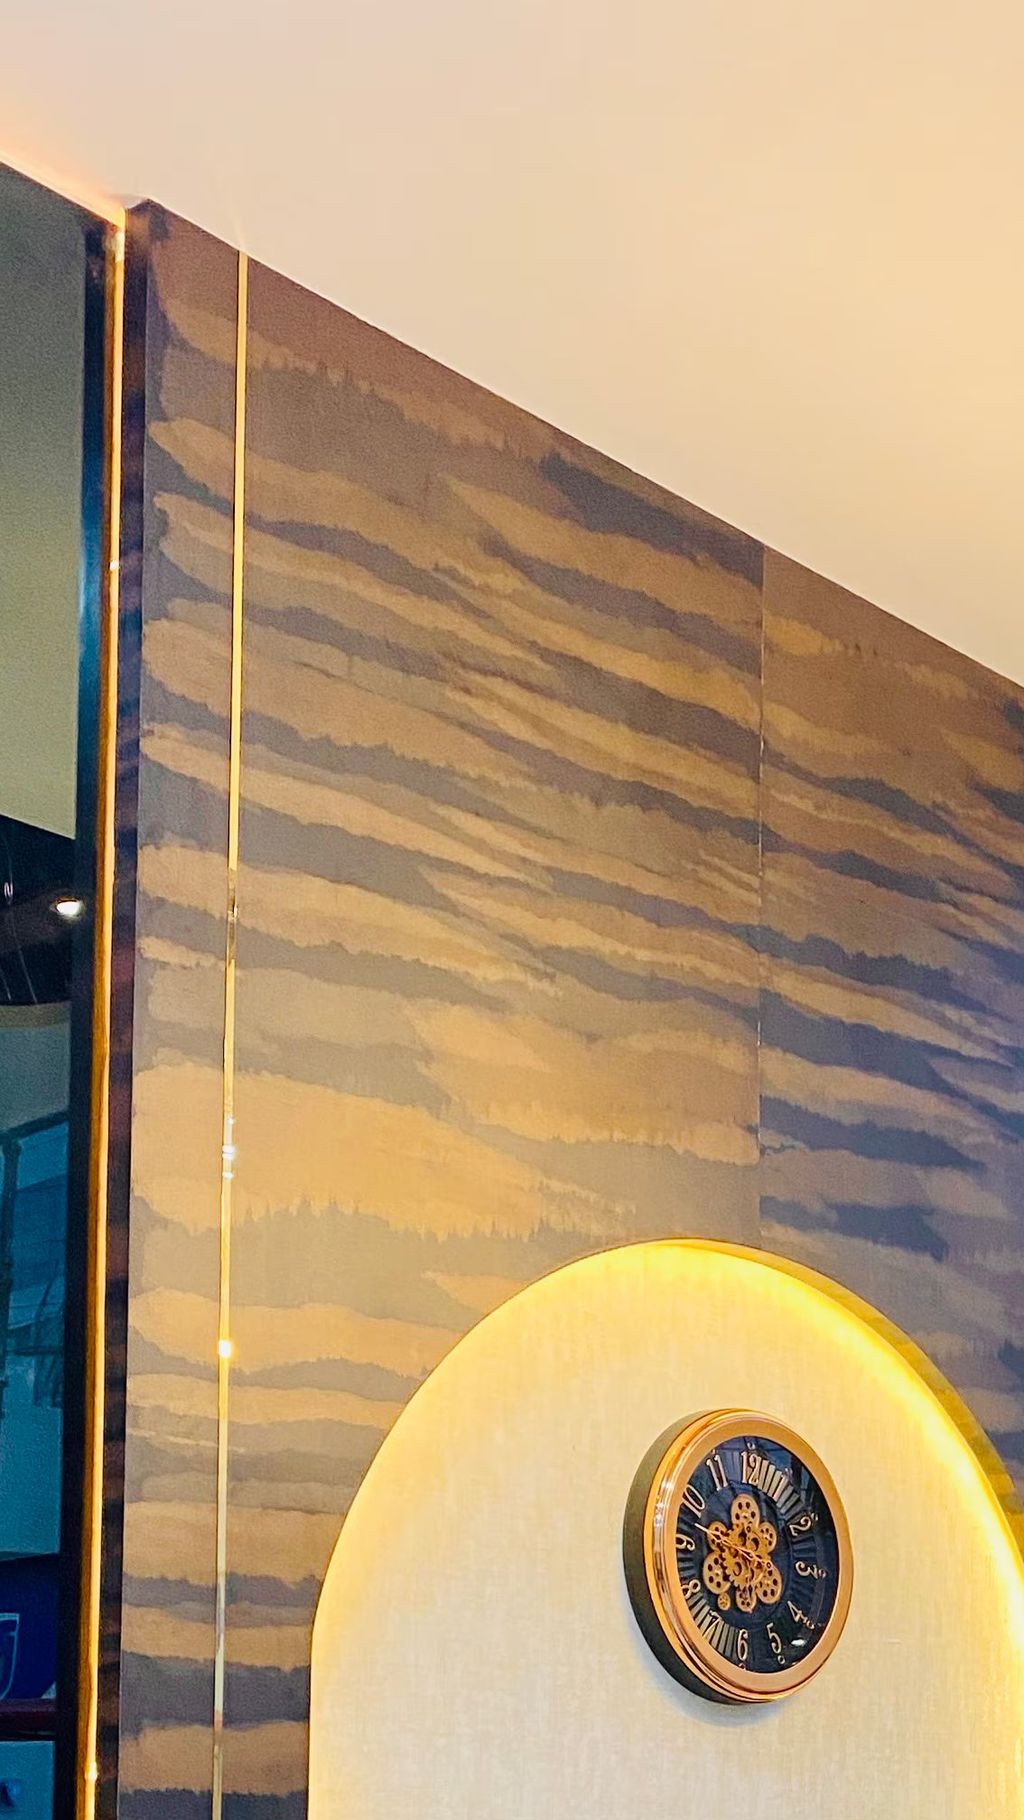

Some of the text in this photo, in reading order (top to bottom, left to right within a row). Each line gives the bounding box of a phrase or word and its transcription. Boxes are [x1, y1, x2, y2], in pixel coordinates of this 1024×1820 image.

[706, 1454, 729, 1491] 11
[740, 1451, 759, 1486] 12
[682, 1484, 706, 1518] 10
[789, 1516, 812, 1537] 2
[676, 1533, 696, 1551] 9
[795, 1561, 819, 1579] 3
[681, 1579, 701, 1599] 8
[787, 1601, 809, 1624] 4
[737, 1628, 749, 1661] 6
[766, 1622, 782, 1654] 5
